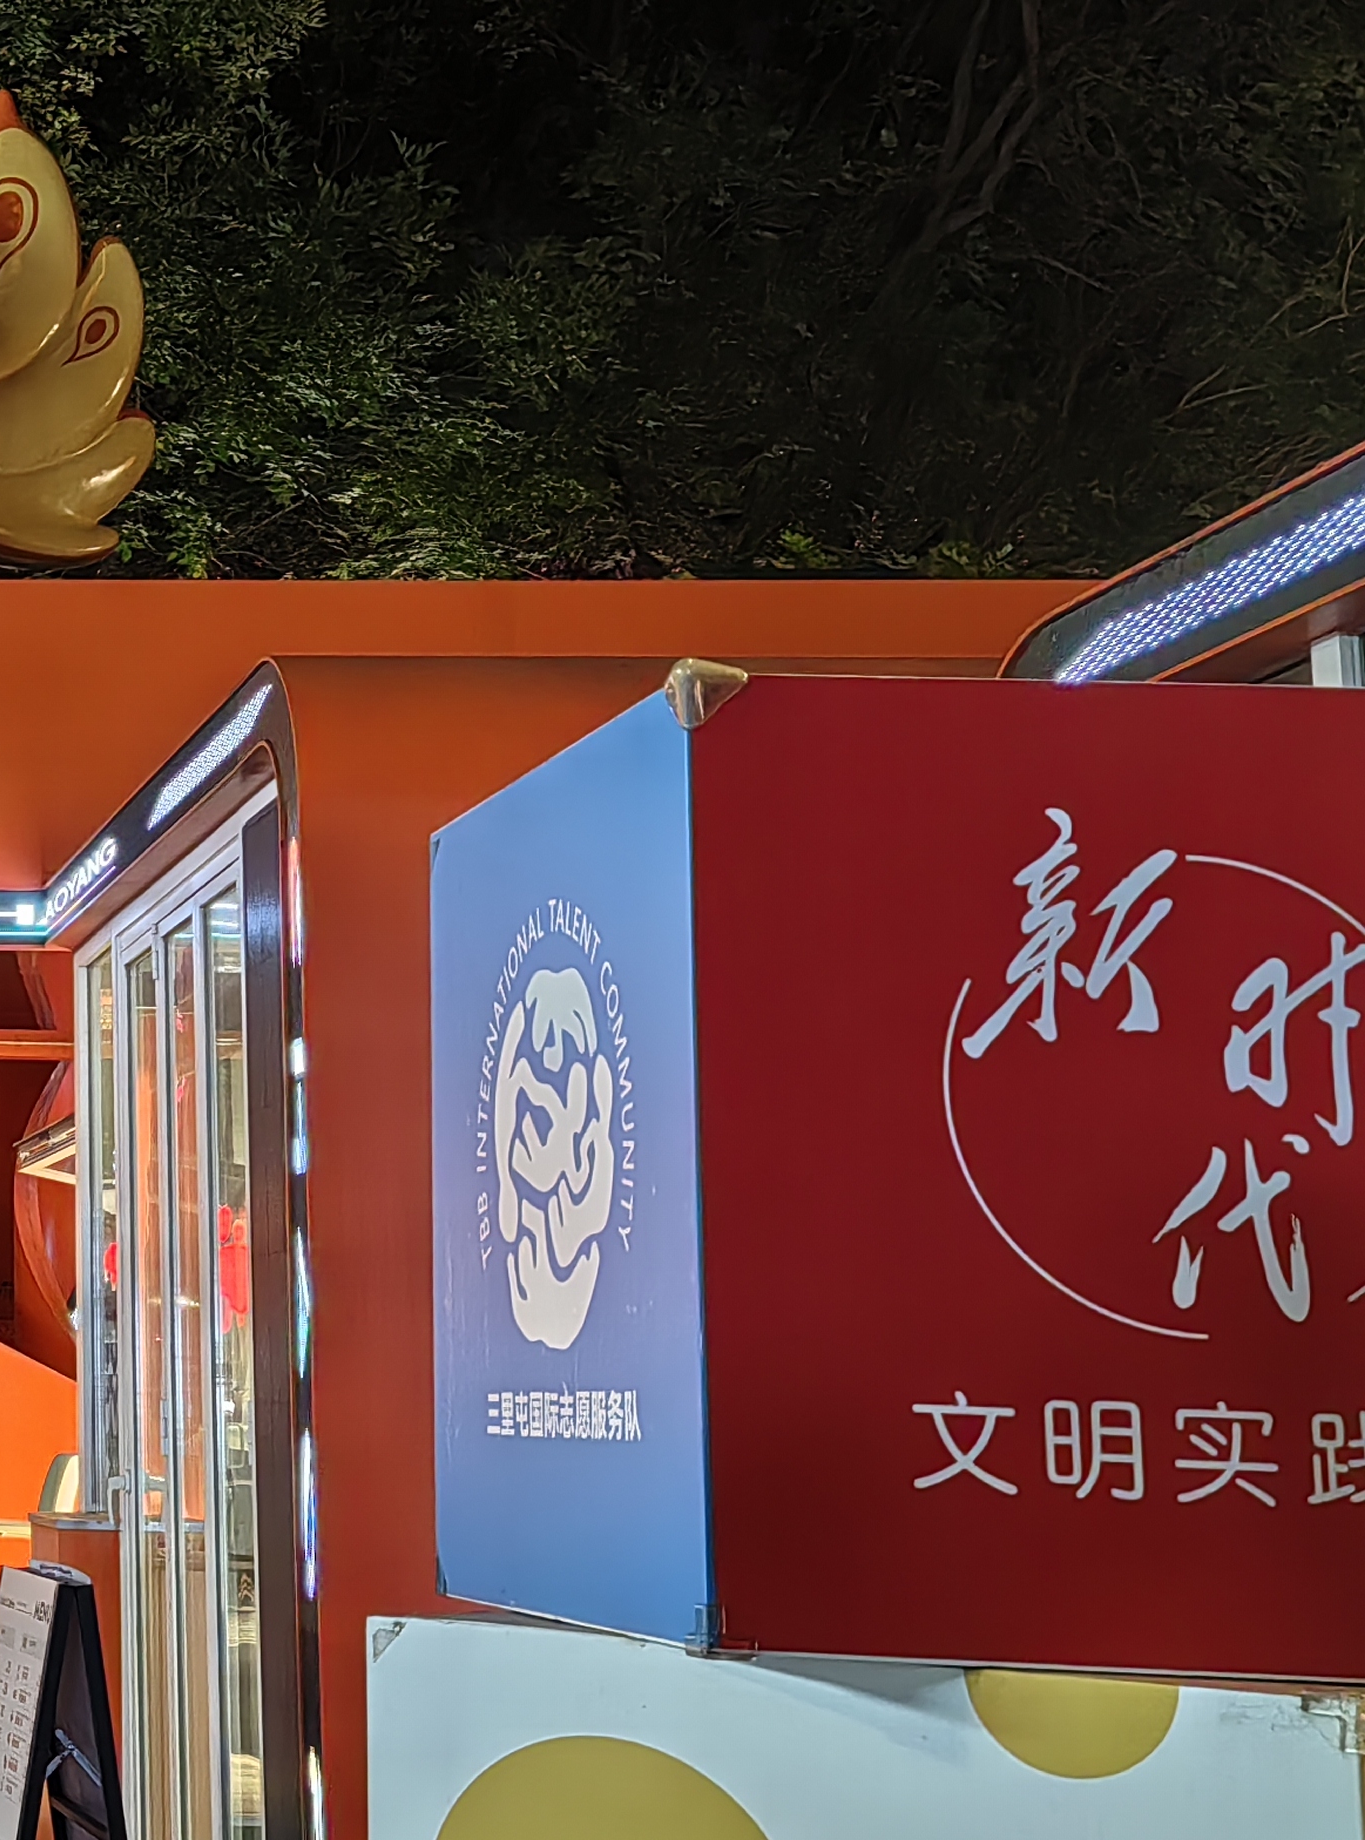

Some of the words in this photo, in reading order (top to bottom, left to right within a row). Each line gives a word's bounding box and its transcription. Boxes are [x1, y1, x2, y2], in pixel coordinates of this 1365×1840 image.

[547, 898, 602, 966] TALENT
[476, 905, 545, 1173] INTERNATIONAL
[599, 960, 636, 1252] COMMUNITY
[475, 1190, 492, 1271] TBB
[486, 1388, 643, 1442] 三里屯国际志愿服务队
